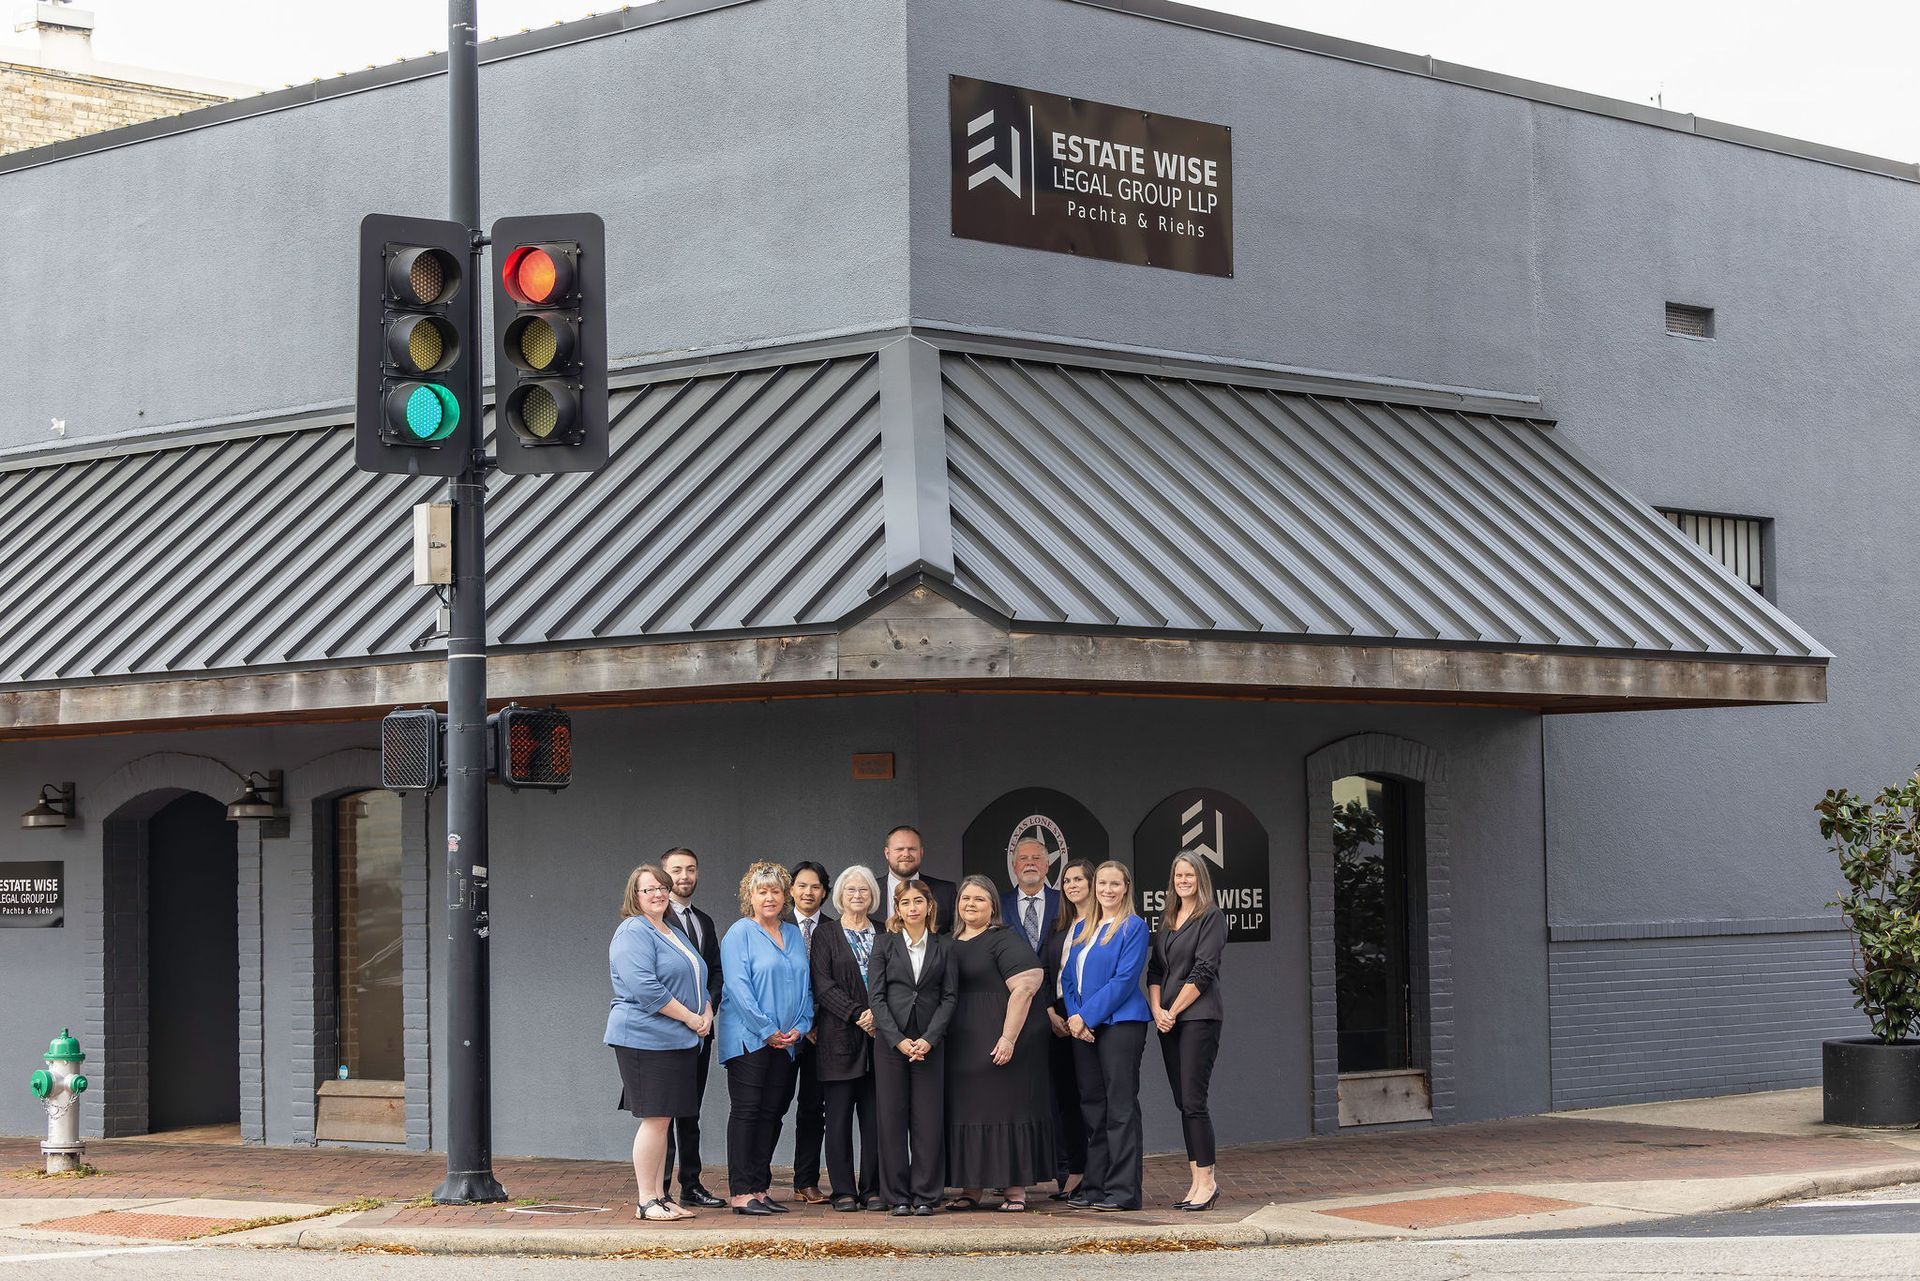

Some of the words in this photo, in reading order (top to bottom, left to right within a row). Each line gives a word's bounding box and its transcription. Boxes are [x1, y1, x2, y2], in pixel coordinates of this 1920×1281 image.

[1052, 132, 1145, 175] ESTATE
[1153, 150, 1218, 188] WISE
[1053, 166, 1113, 198] LEGAL
[1118, 178, 1182, 208] GROUP
[1188, 190, 1218, 214] LLP
[1068, 201, 1127, 226] Pachta
[1138, 213, 1148, 229] &
[1159, 216, 1205, 238] Riehs
[1029, 816, 1053, 829] LONE
[1052, 827, 1067, 854] STAR
[34, 879, 58, 891] WISE
[21, 893, 45, 903] GROUP
[46, 893, 58, 903] LLP
[1216, 888, 1263, 909] WISE
[2, 907, 24, 915] Pachta
[34, 906, 53, 915] Riehs
[1241, 913, 1263, 930] LLP
